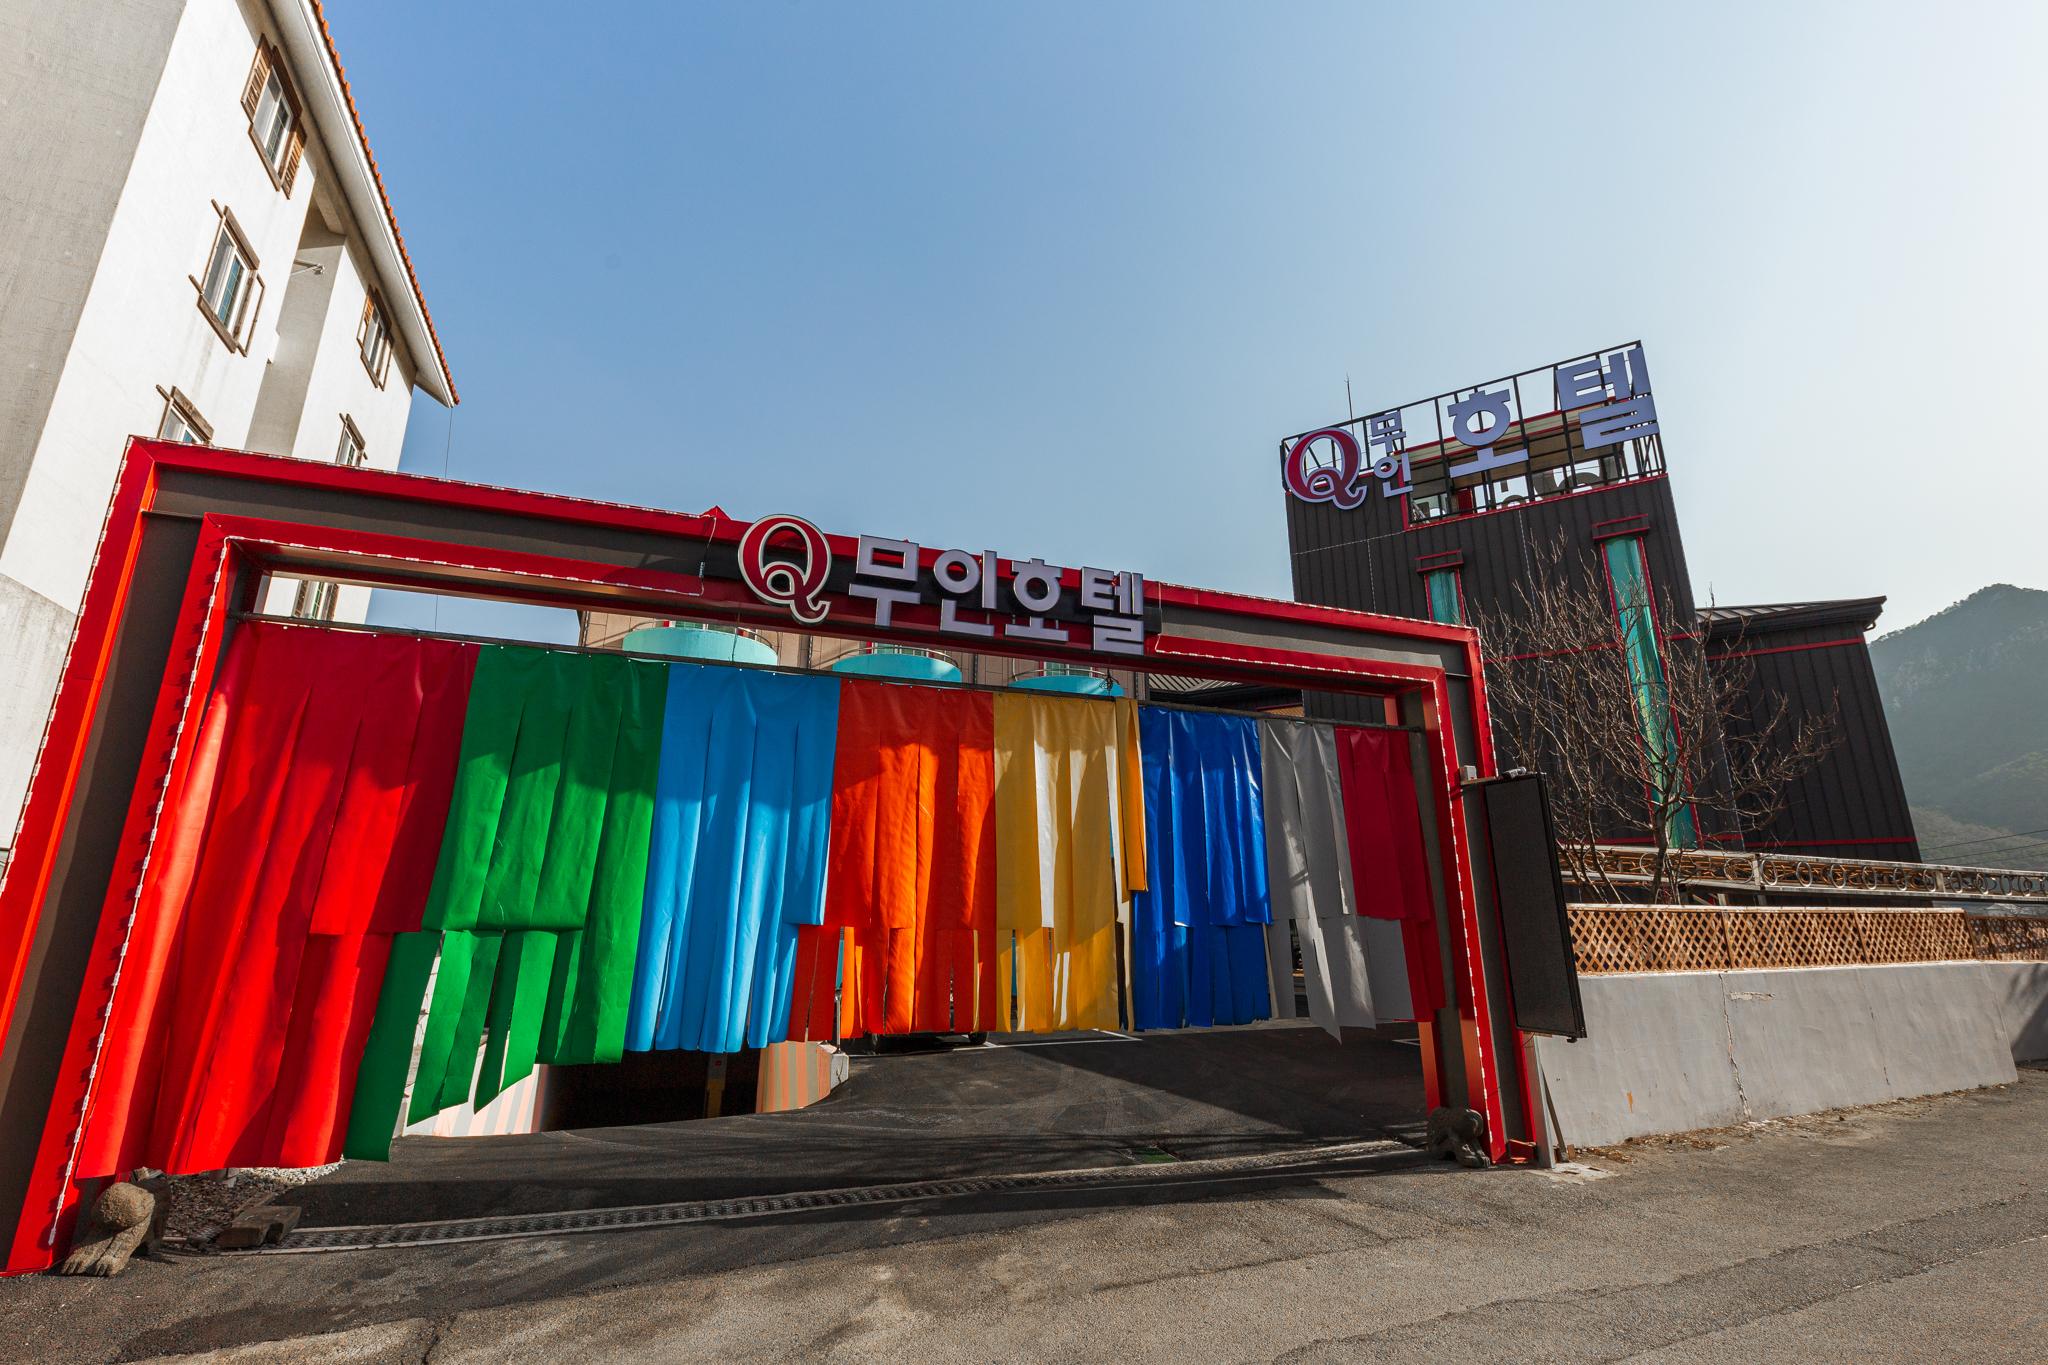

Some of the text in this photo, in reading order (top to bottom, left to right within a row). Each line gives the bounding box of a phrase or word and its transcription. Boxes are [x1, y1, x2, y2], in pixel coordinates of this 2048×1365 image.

[1284, 426, 1368, 511] Q
[1369, 409, 1413, 498] 무인
[1448, 346, 1660, 478] 호텔
[737, 513, 1145, 656] Q 무인호텔
